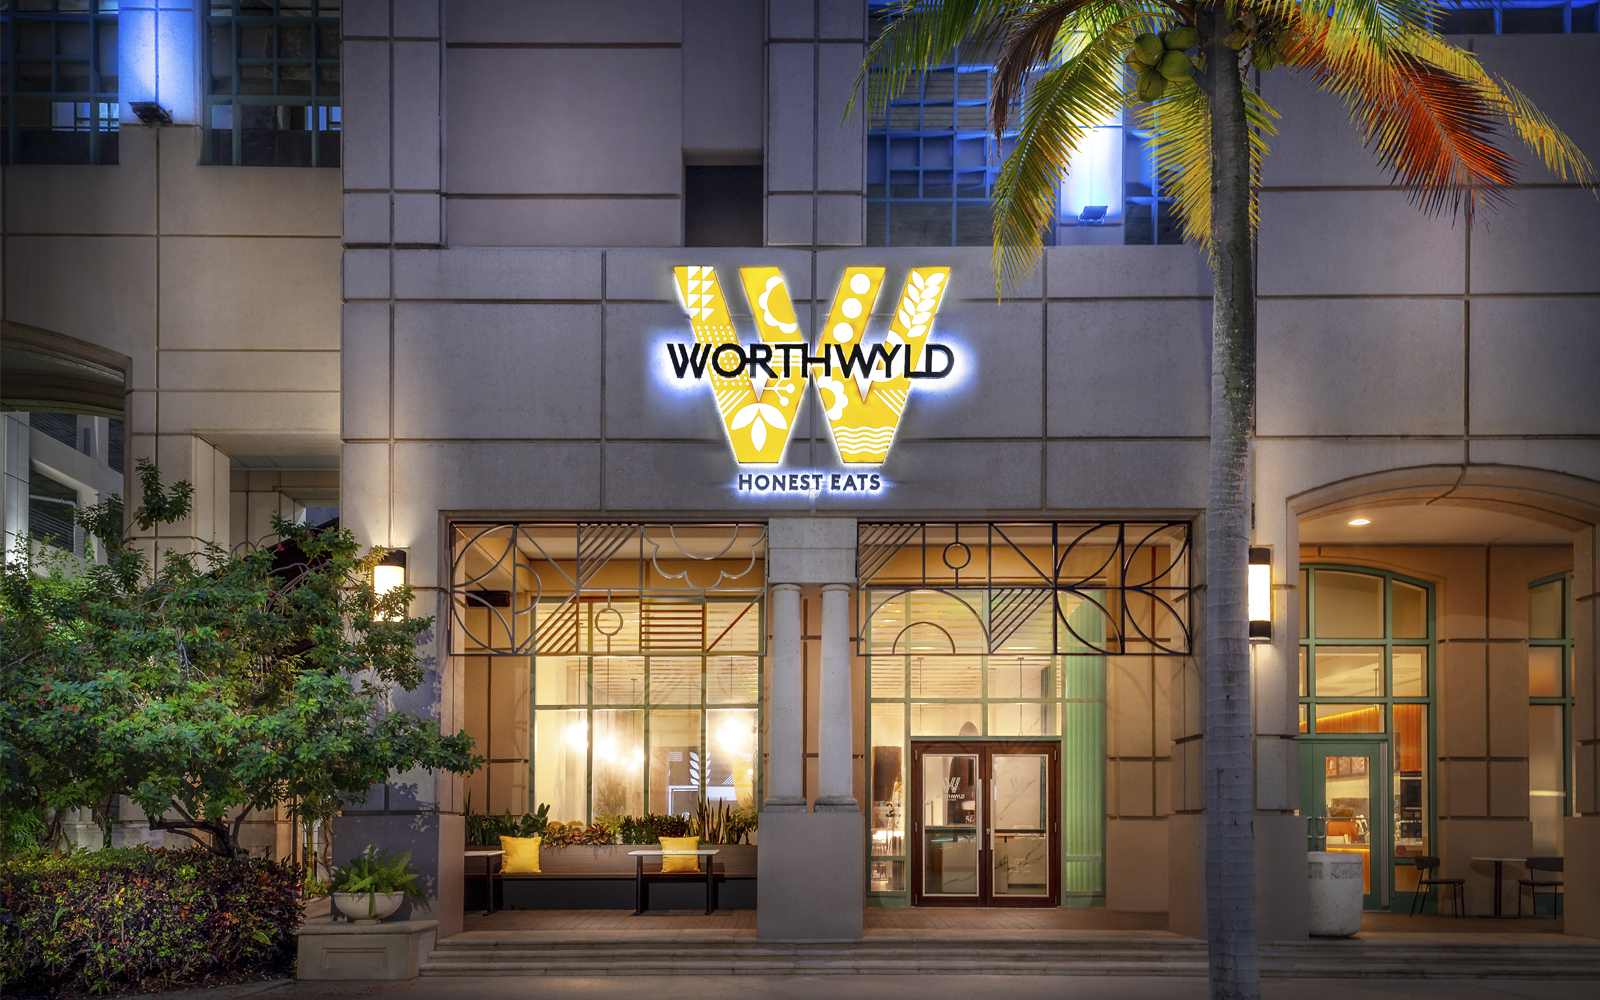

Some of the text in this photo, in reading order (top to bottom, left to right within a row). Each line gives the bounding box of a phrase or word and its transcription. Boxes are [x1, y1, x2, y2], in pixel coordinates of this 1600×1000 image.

[667, 343, 954, 378] WORTHWYLD
[738, 474, 881, 490] HONEST EATS
